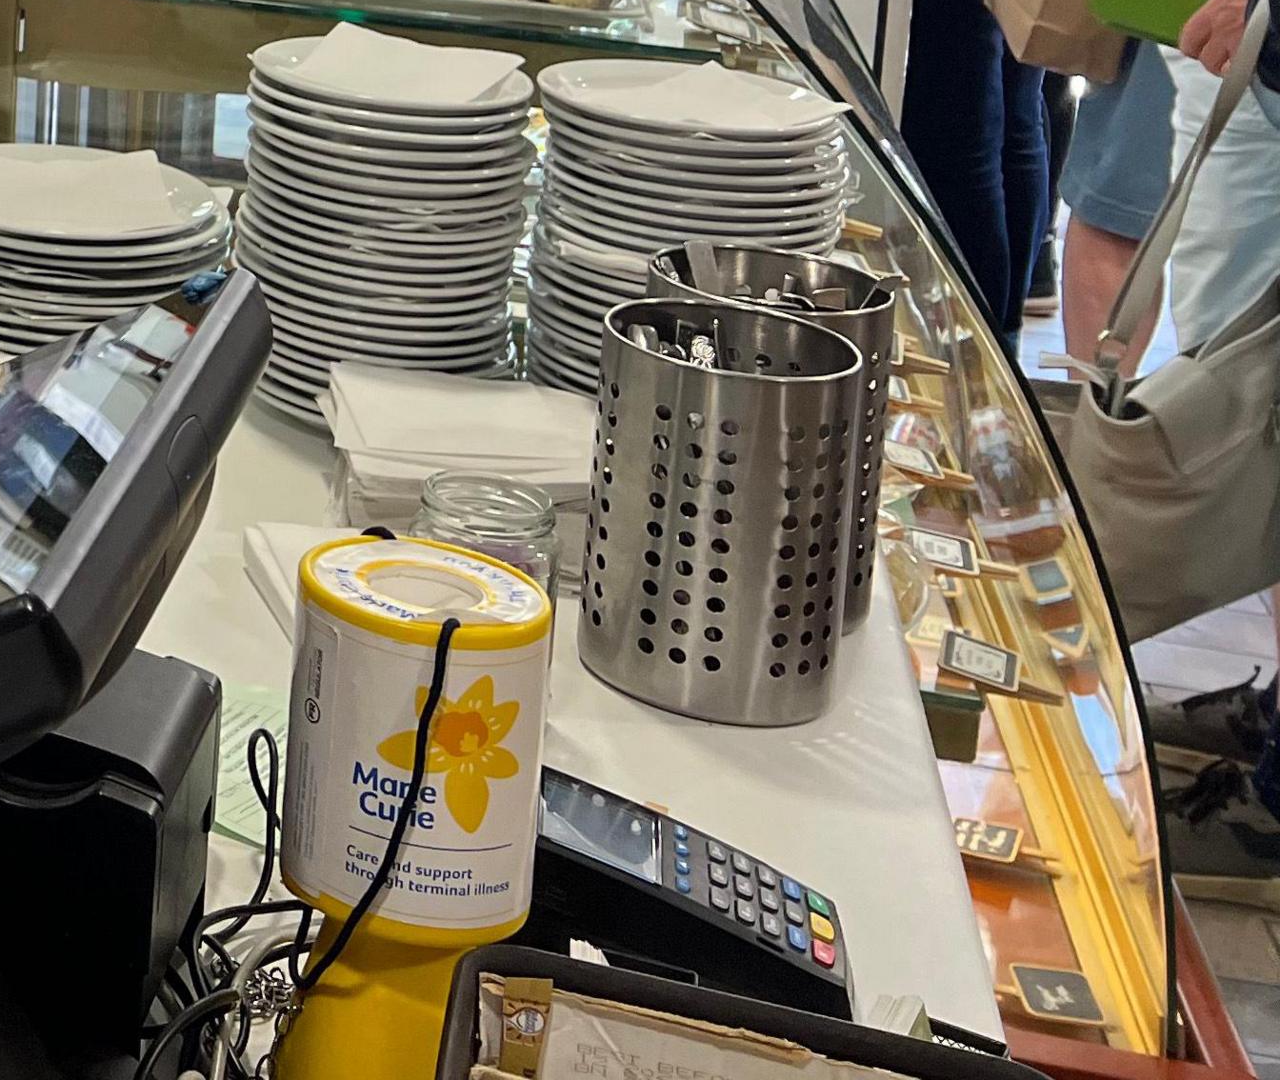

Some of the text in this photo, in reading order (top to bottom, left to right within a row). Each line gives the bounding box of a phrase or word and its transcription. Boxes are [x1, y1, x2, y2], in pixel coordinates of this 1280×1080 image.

[352, 761, 438, 805] Mare
[359, 791, 435, 830] Cuie
[344, 860, 510, 897] throgh terminal illness
[346, 844, 474, 883] Care nd support
